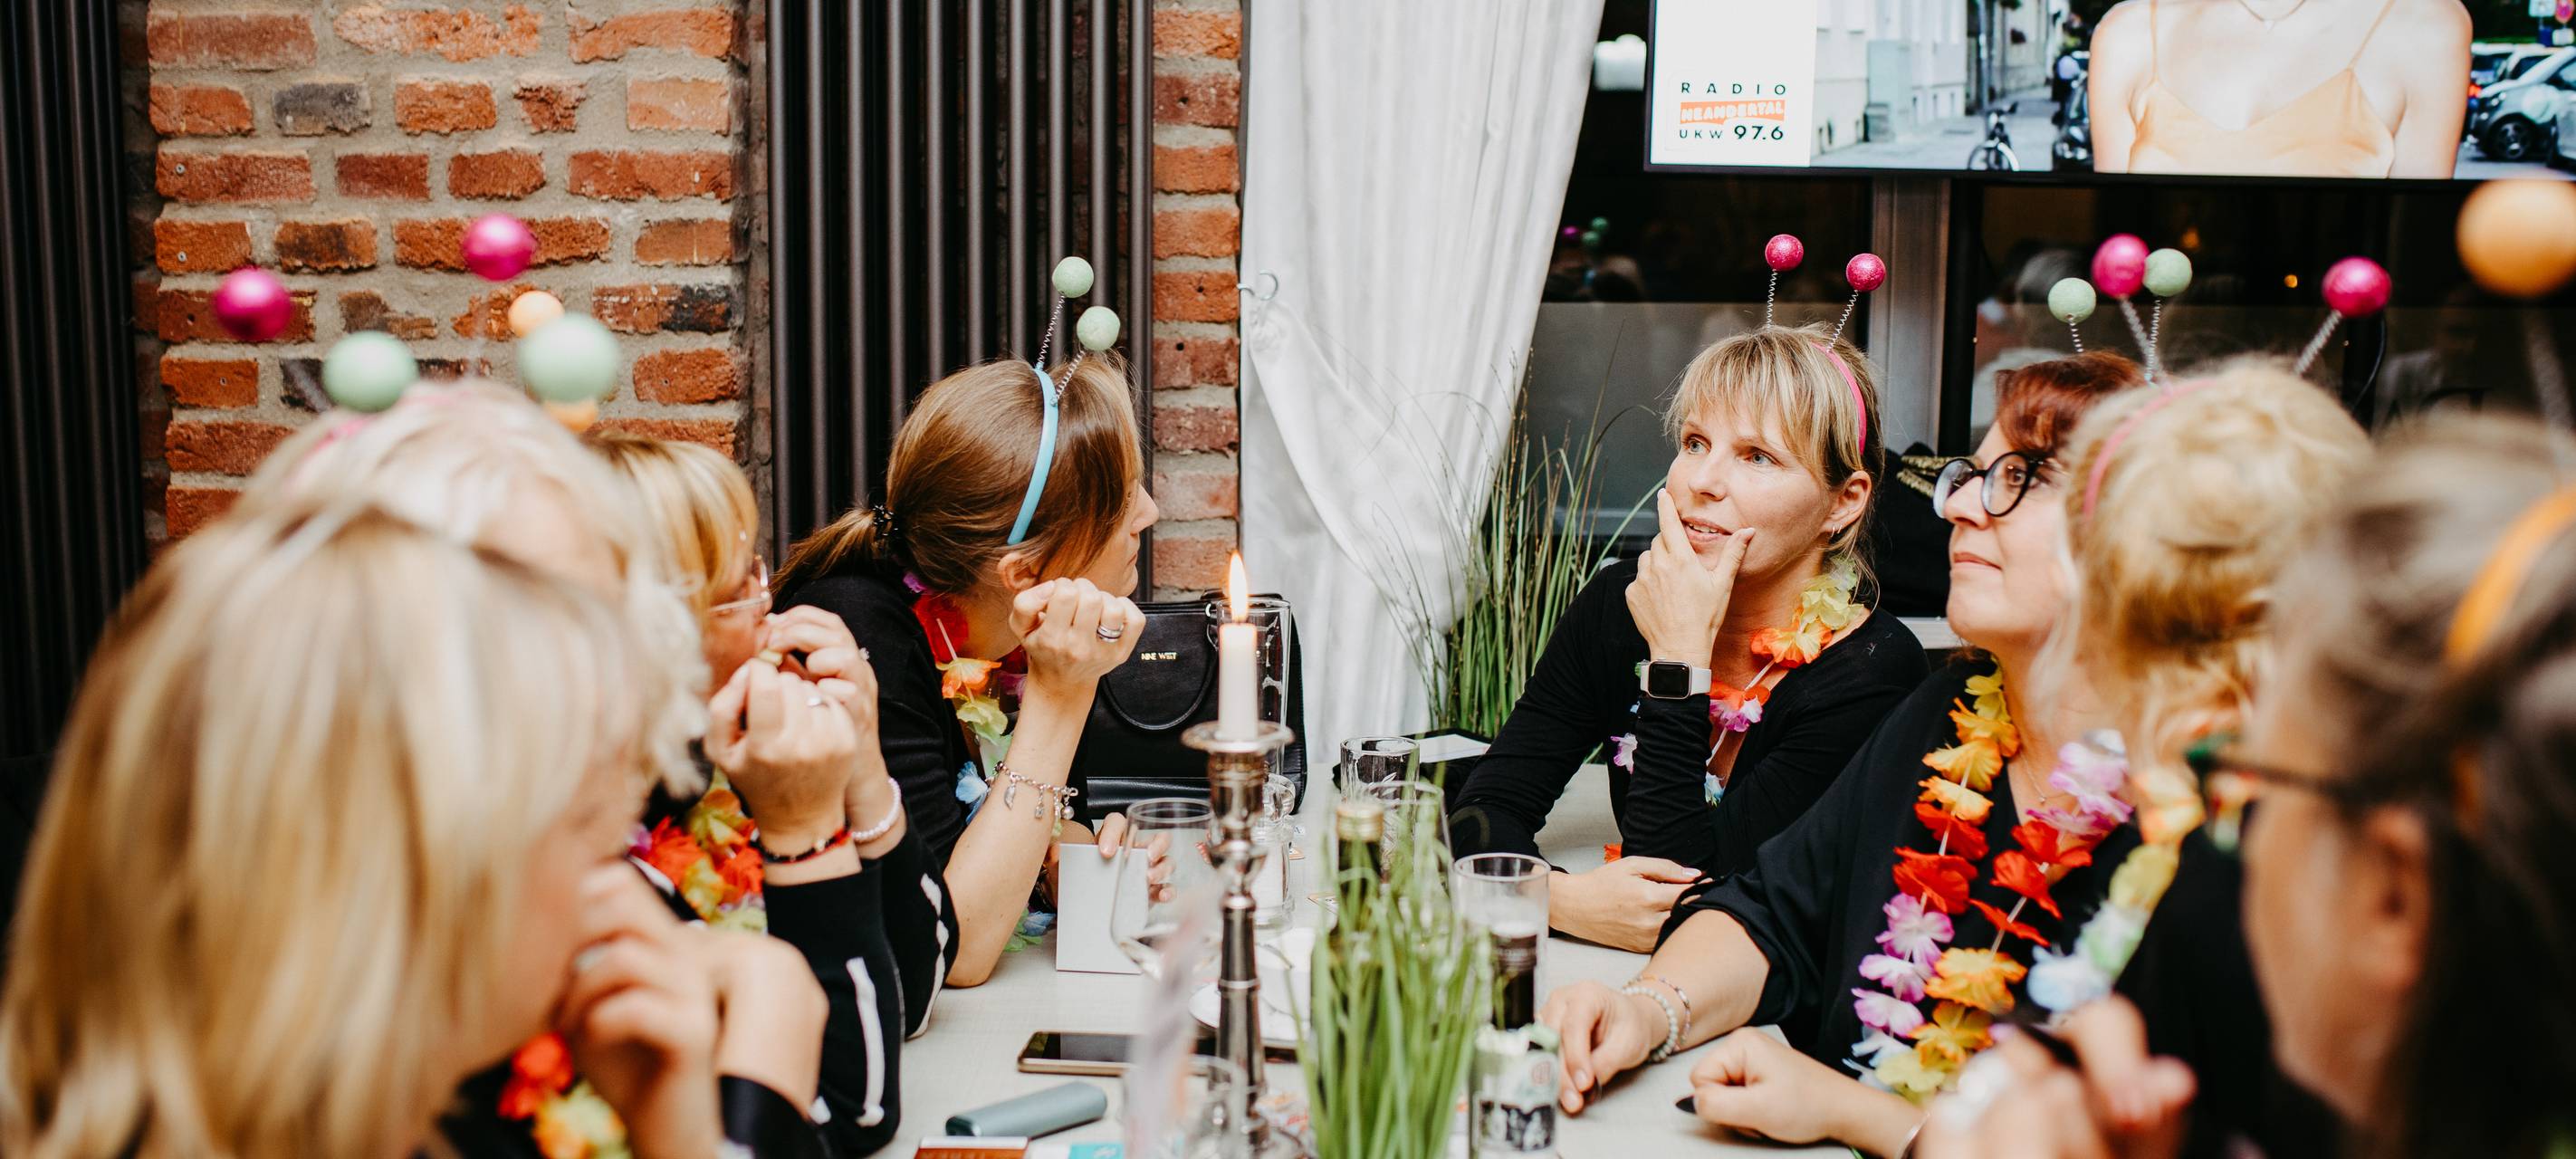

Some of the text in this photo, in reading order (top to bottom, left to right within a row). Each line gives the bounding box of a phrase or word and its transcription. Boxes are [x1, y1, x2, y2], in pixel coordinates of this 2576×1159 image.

[1681, 81, 1786, 96] RADIO
[1681, 101, 1784, 121] NEANDERTAL
[1679, 125, 1784, 140] UKW 97.6
